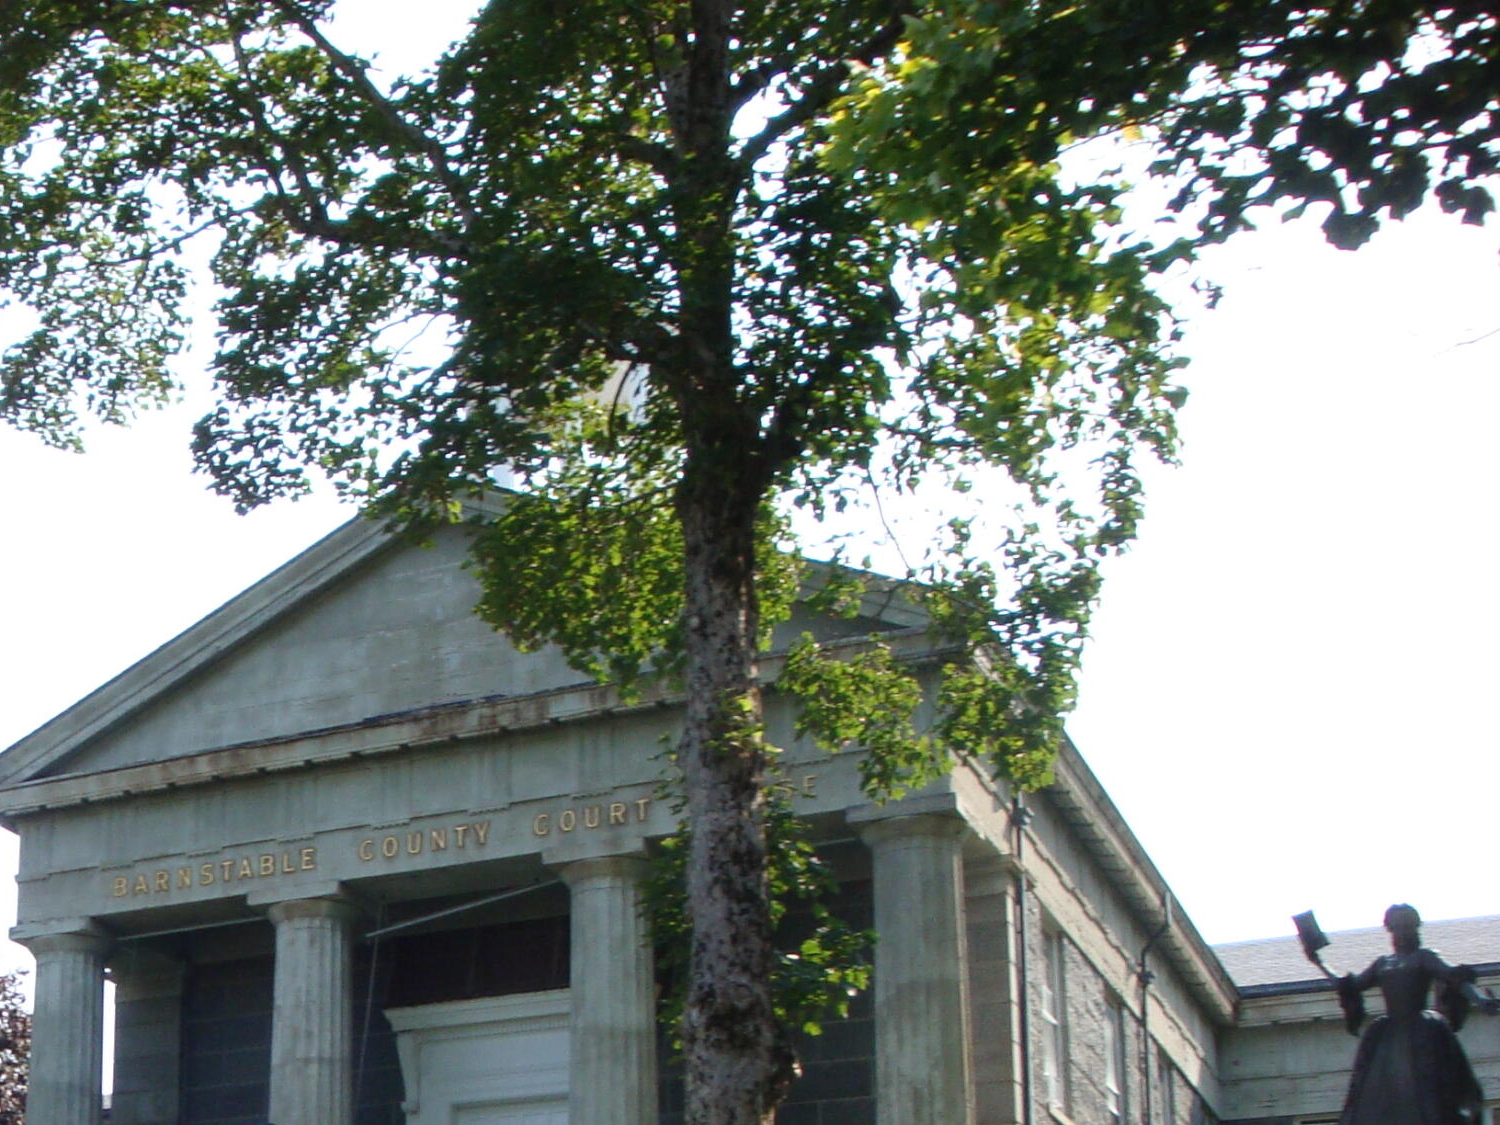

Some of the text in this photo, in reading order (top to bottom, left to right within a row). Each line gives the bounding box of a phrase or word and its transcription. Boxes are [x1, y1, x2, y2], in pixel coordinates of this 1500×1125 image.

[113, 798, 649, 897] BARNSTABLE COUNTY COURT
